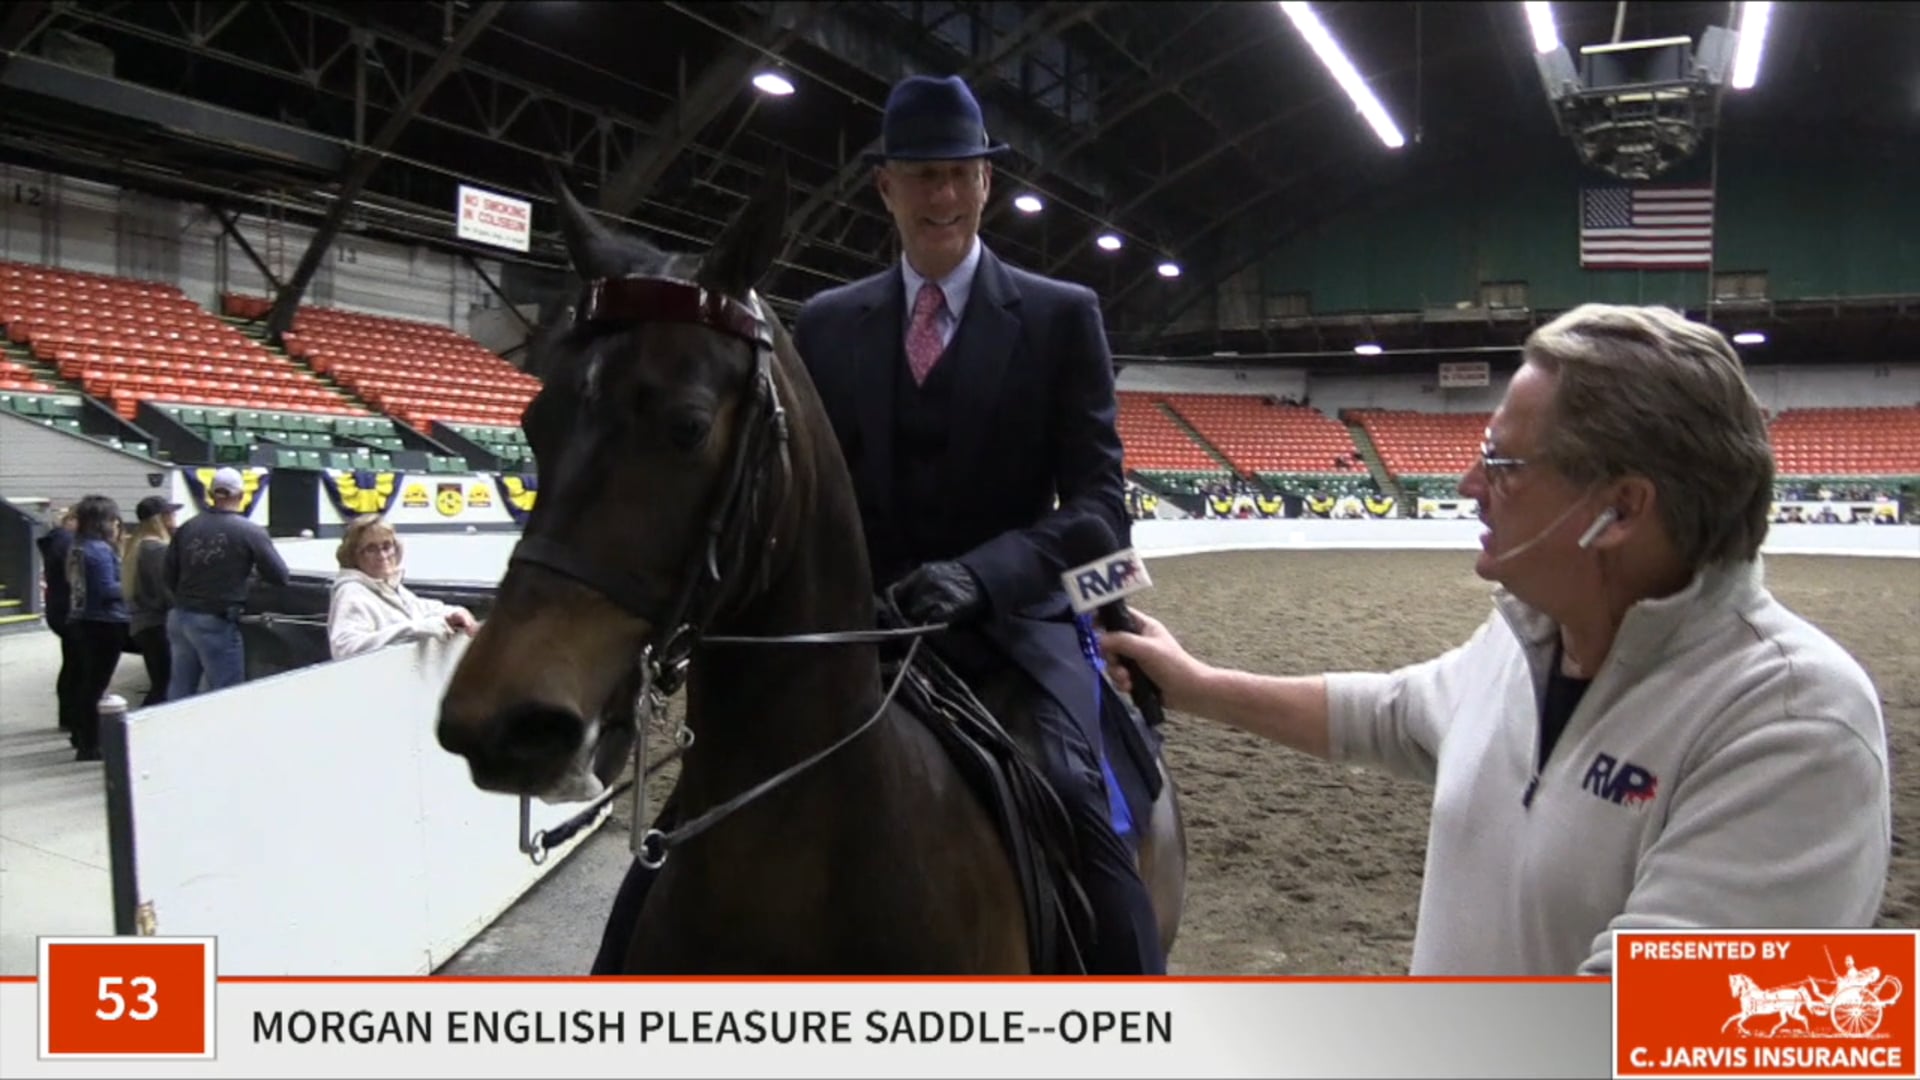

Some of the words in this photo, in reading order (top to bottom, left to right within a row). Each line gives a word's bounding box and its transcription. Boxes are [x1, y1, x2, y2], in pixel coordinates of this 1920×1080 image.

[14, 183, 41, 206] 12
[464, 193, 479, 207] NO
[483, 198, 526, 219] SMOKING
